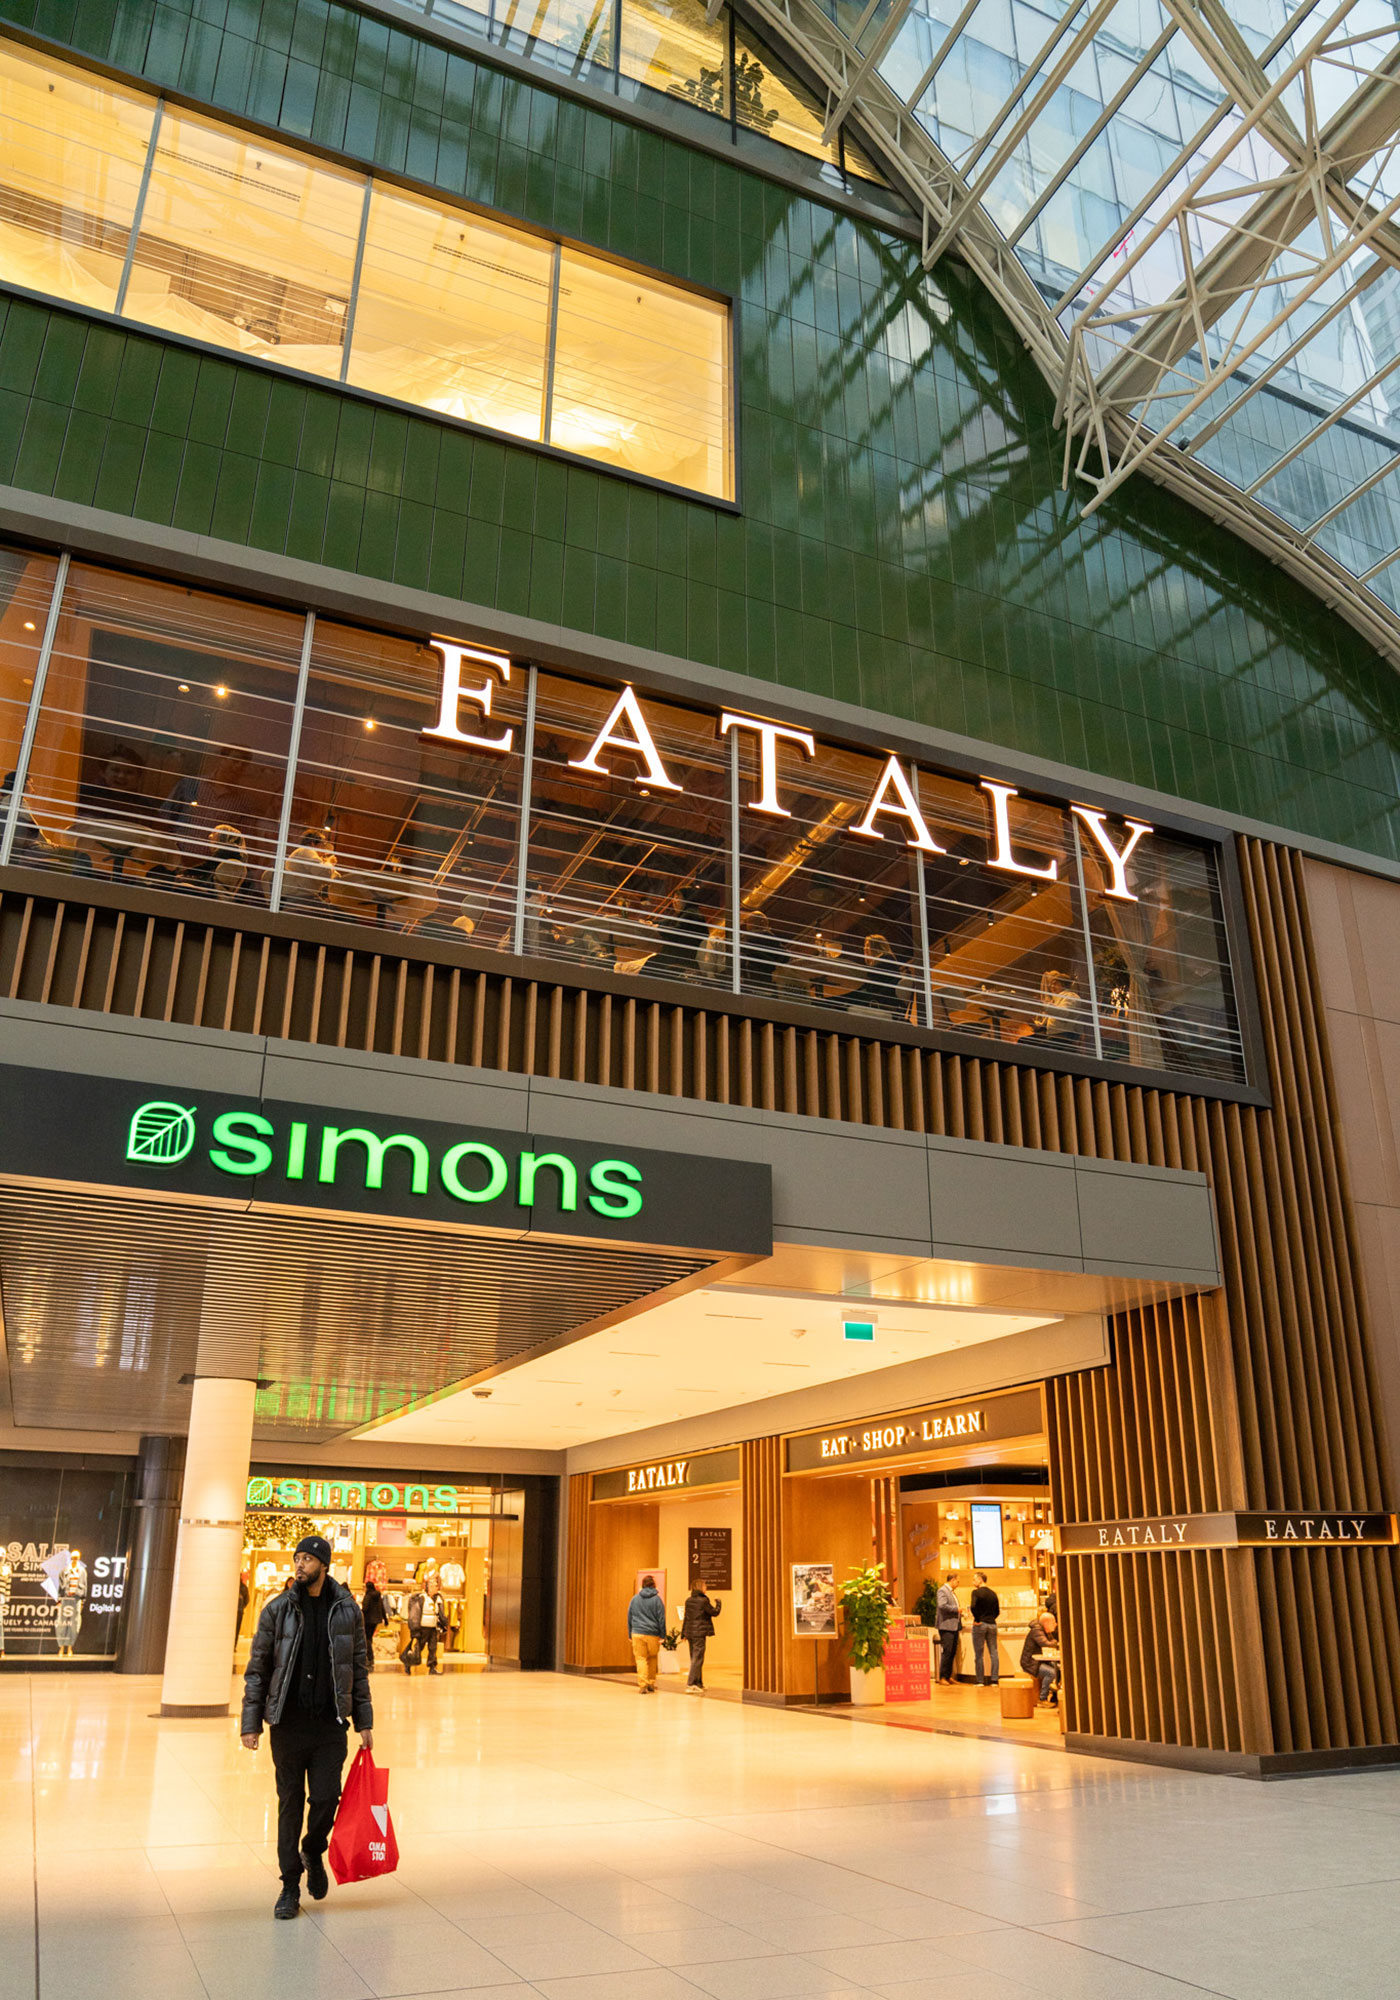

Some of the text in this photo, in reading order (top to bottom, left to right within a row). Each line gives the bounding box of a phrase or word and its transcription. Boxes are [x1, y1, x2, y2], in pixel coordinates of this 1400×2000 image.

[422, 640, 1154, 902] EATALY
[209, 1111, 644, 1219] simons
[821, 1411, 980, 1457] EAT SHOP LEARN
[628, 1462, 687, 1491] EATALY
[278, 1479, 458, 1511] simons
[1098, 1523, 1187, 1546] EATALY
[1264, 1520, 1366, 1539] EATALY
[692, 1553, 699, 1564] 2
[0, 1604, 74, 1617] simons
